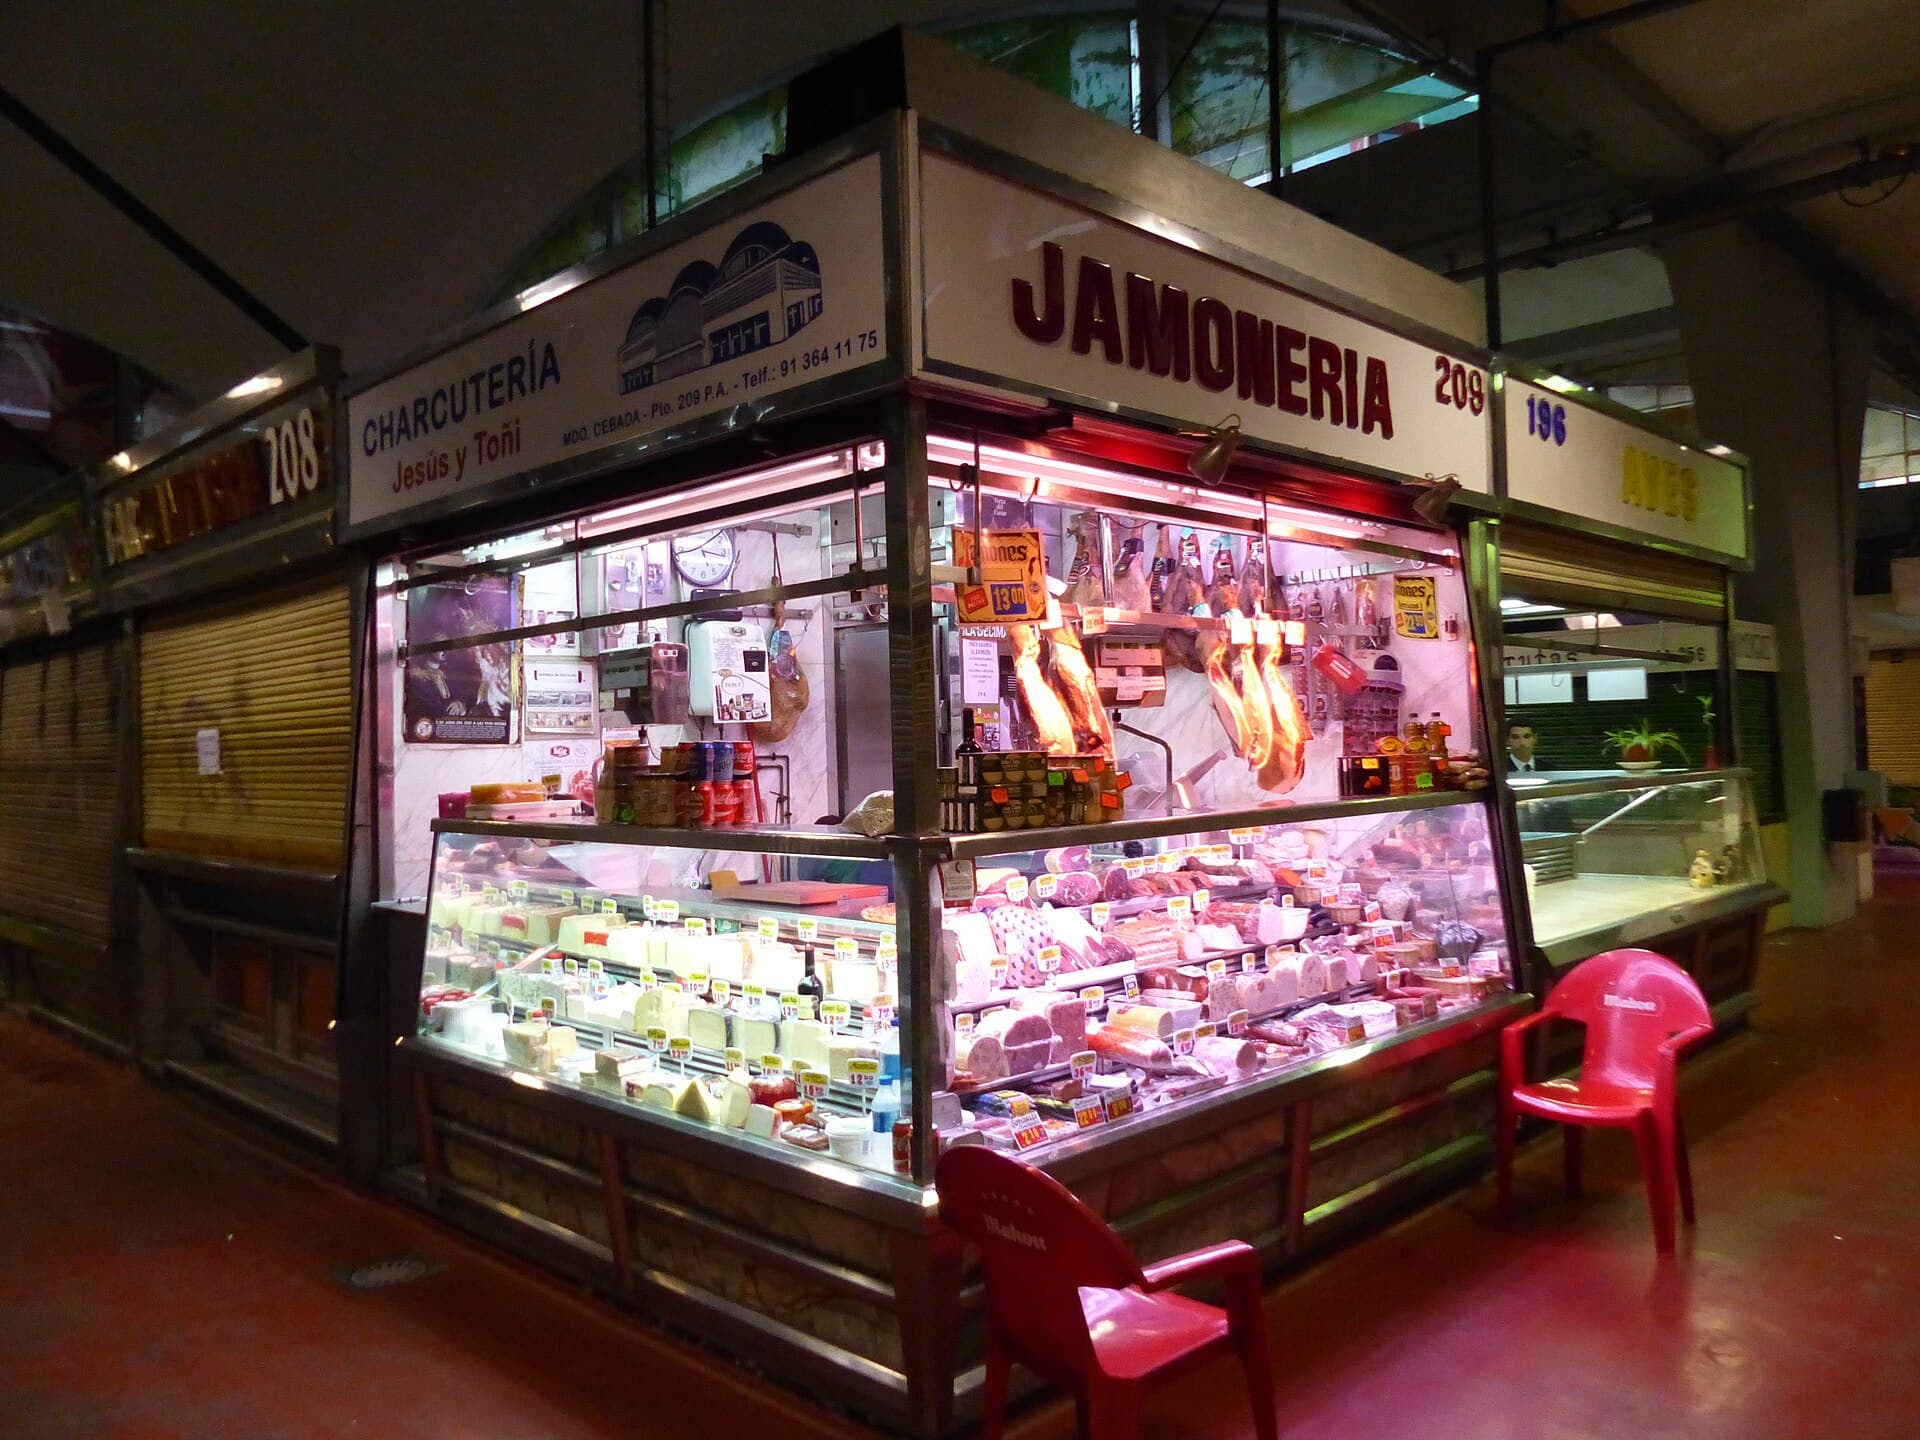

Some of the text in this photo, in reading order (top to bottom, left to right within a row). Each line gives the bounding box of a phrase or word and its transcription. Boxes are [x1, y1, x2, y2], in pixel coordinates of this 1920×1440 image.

[1011, 240, 1394, 440] JAMONERIA
[362, 338, 562, 457] CHARCUTERÍA
[593, 410, 640, 438] CEBADA
[678, 389, 701, 411] 209
[780, 358, 797, 378] 91
[802, 346, 829, 371] 364
[835, 340, 852, 360] 11
[858, 330, 878, 352] 75
[1434, 355, 1485, 416] 209
[1526, 393, 1567, 447] 196
[265, 408, 319, 504] 208
[392, 418, 521, 494] Jesús y Toñi
[700, 570, 706, 579] 6
[711, 567, 717, 576] 5
